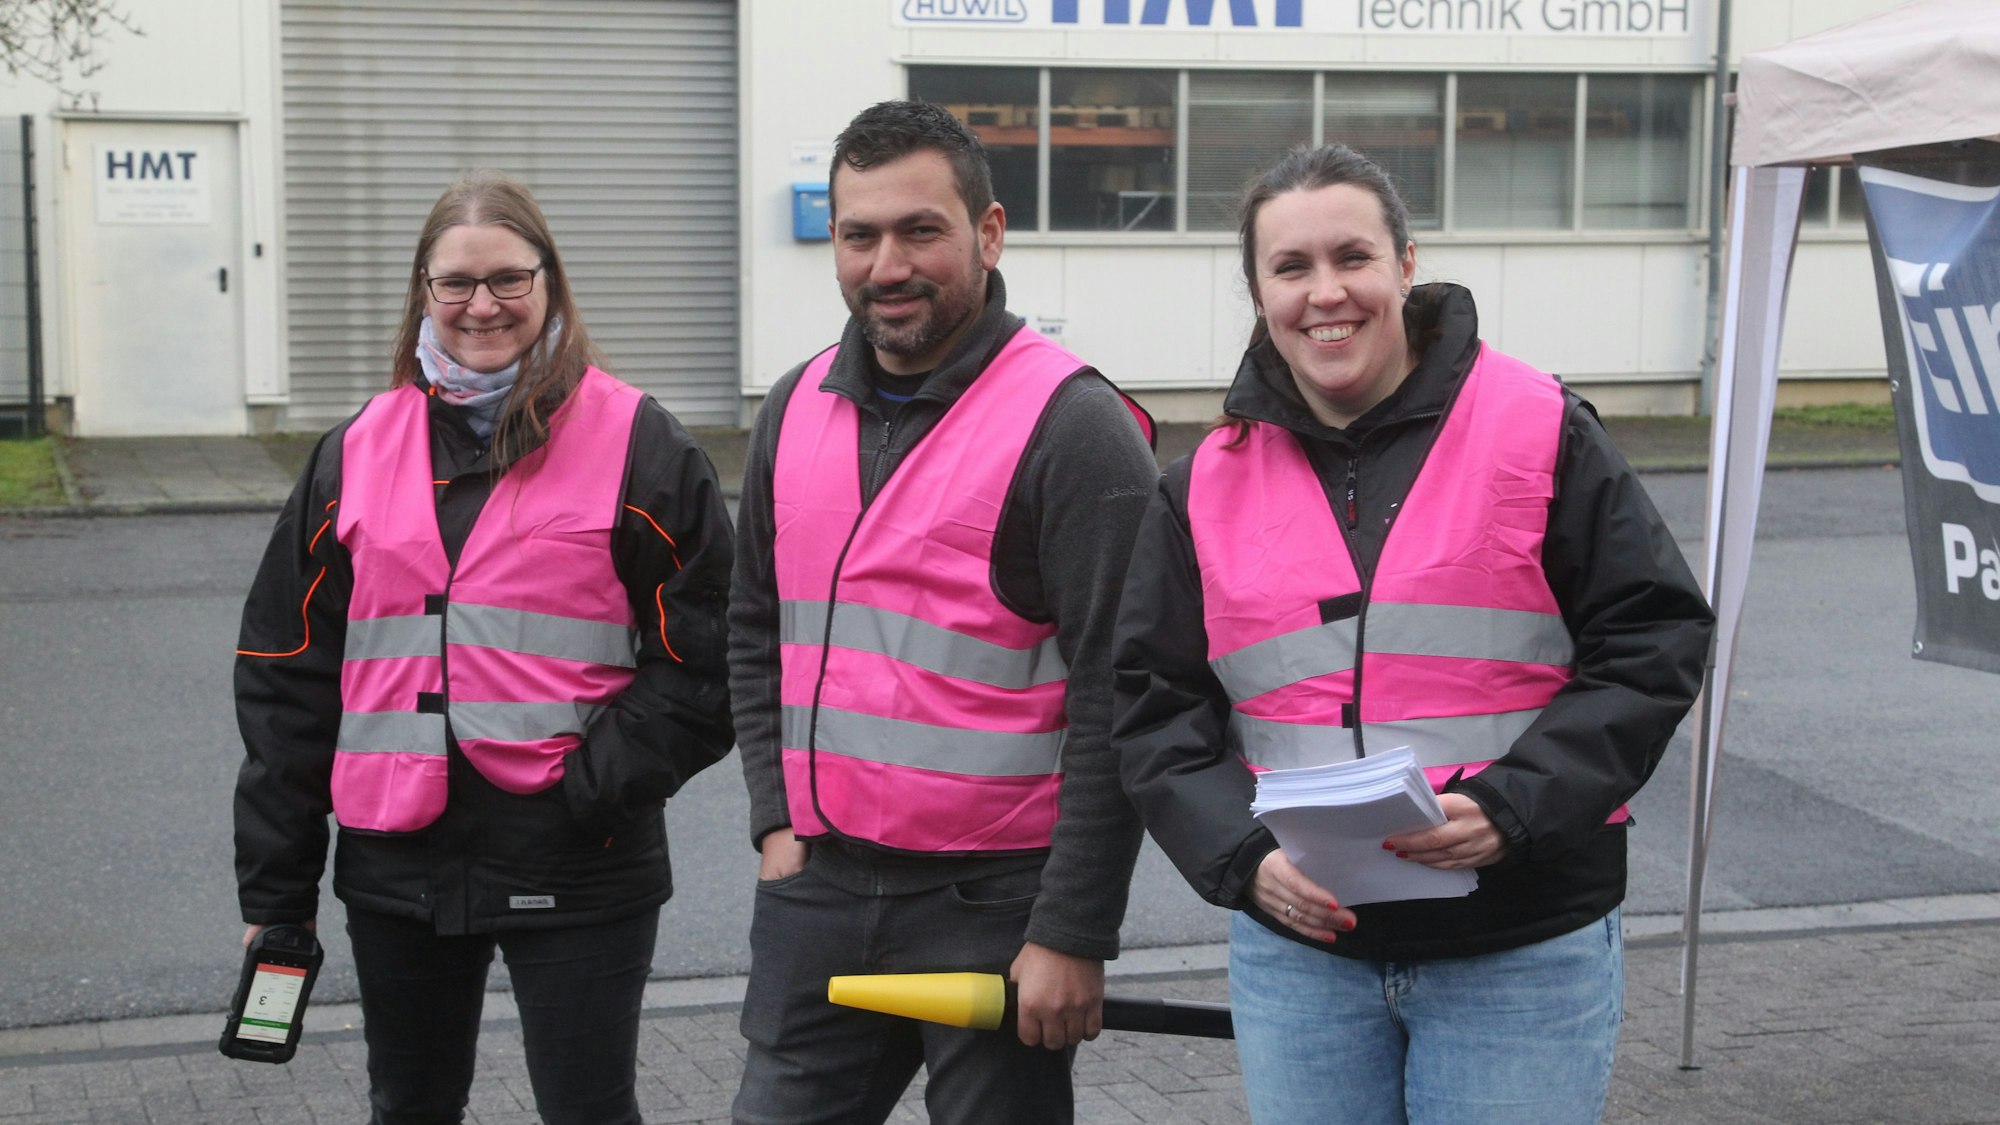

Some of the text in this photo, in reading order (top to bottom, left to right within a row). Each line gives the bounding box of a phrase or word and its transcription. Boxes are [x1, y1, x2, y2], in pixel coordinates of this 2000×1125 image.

[1542, 0, 1688, 31] GmbH
[107, 151, 197, 180] HMT
[259, 996, 267, 1005] 3
